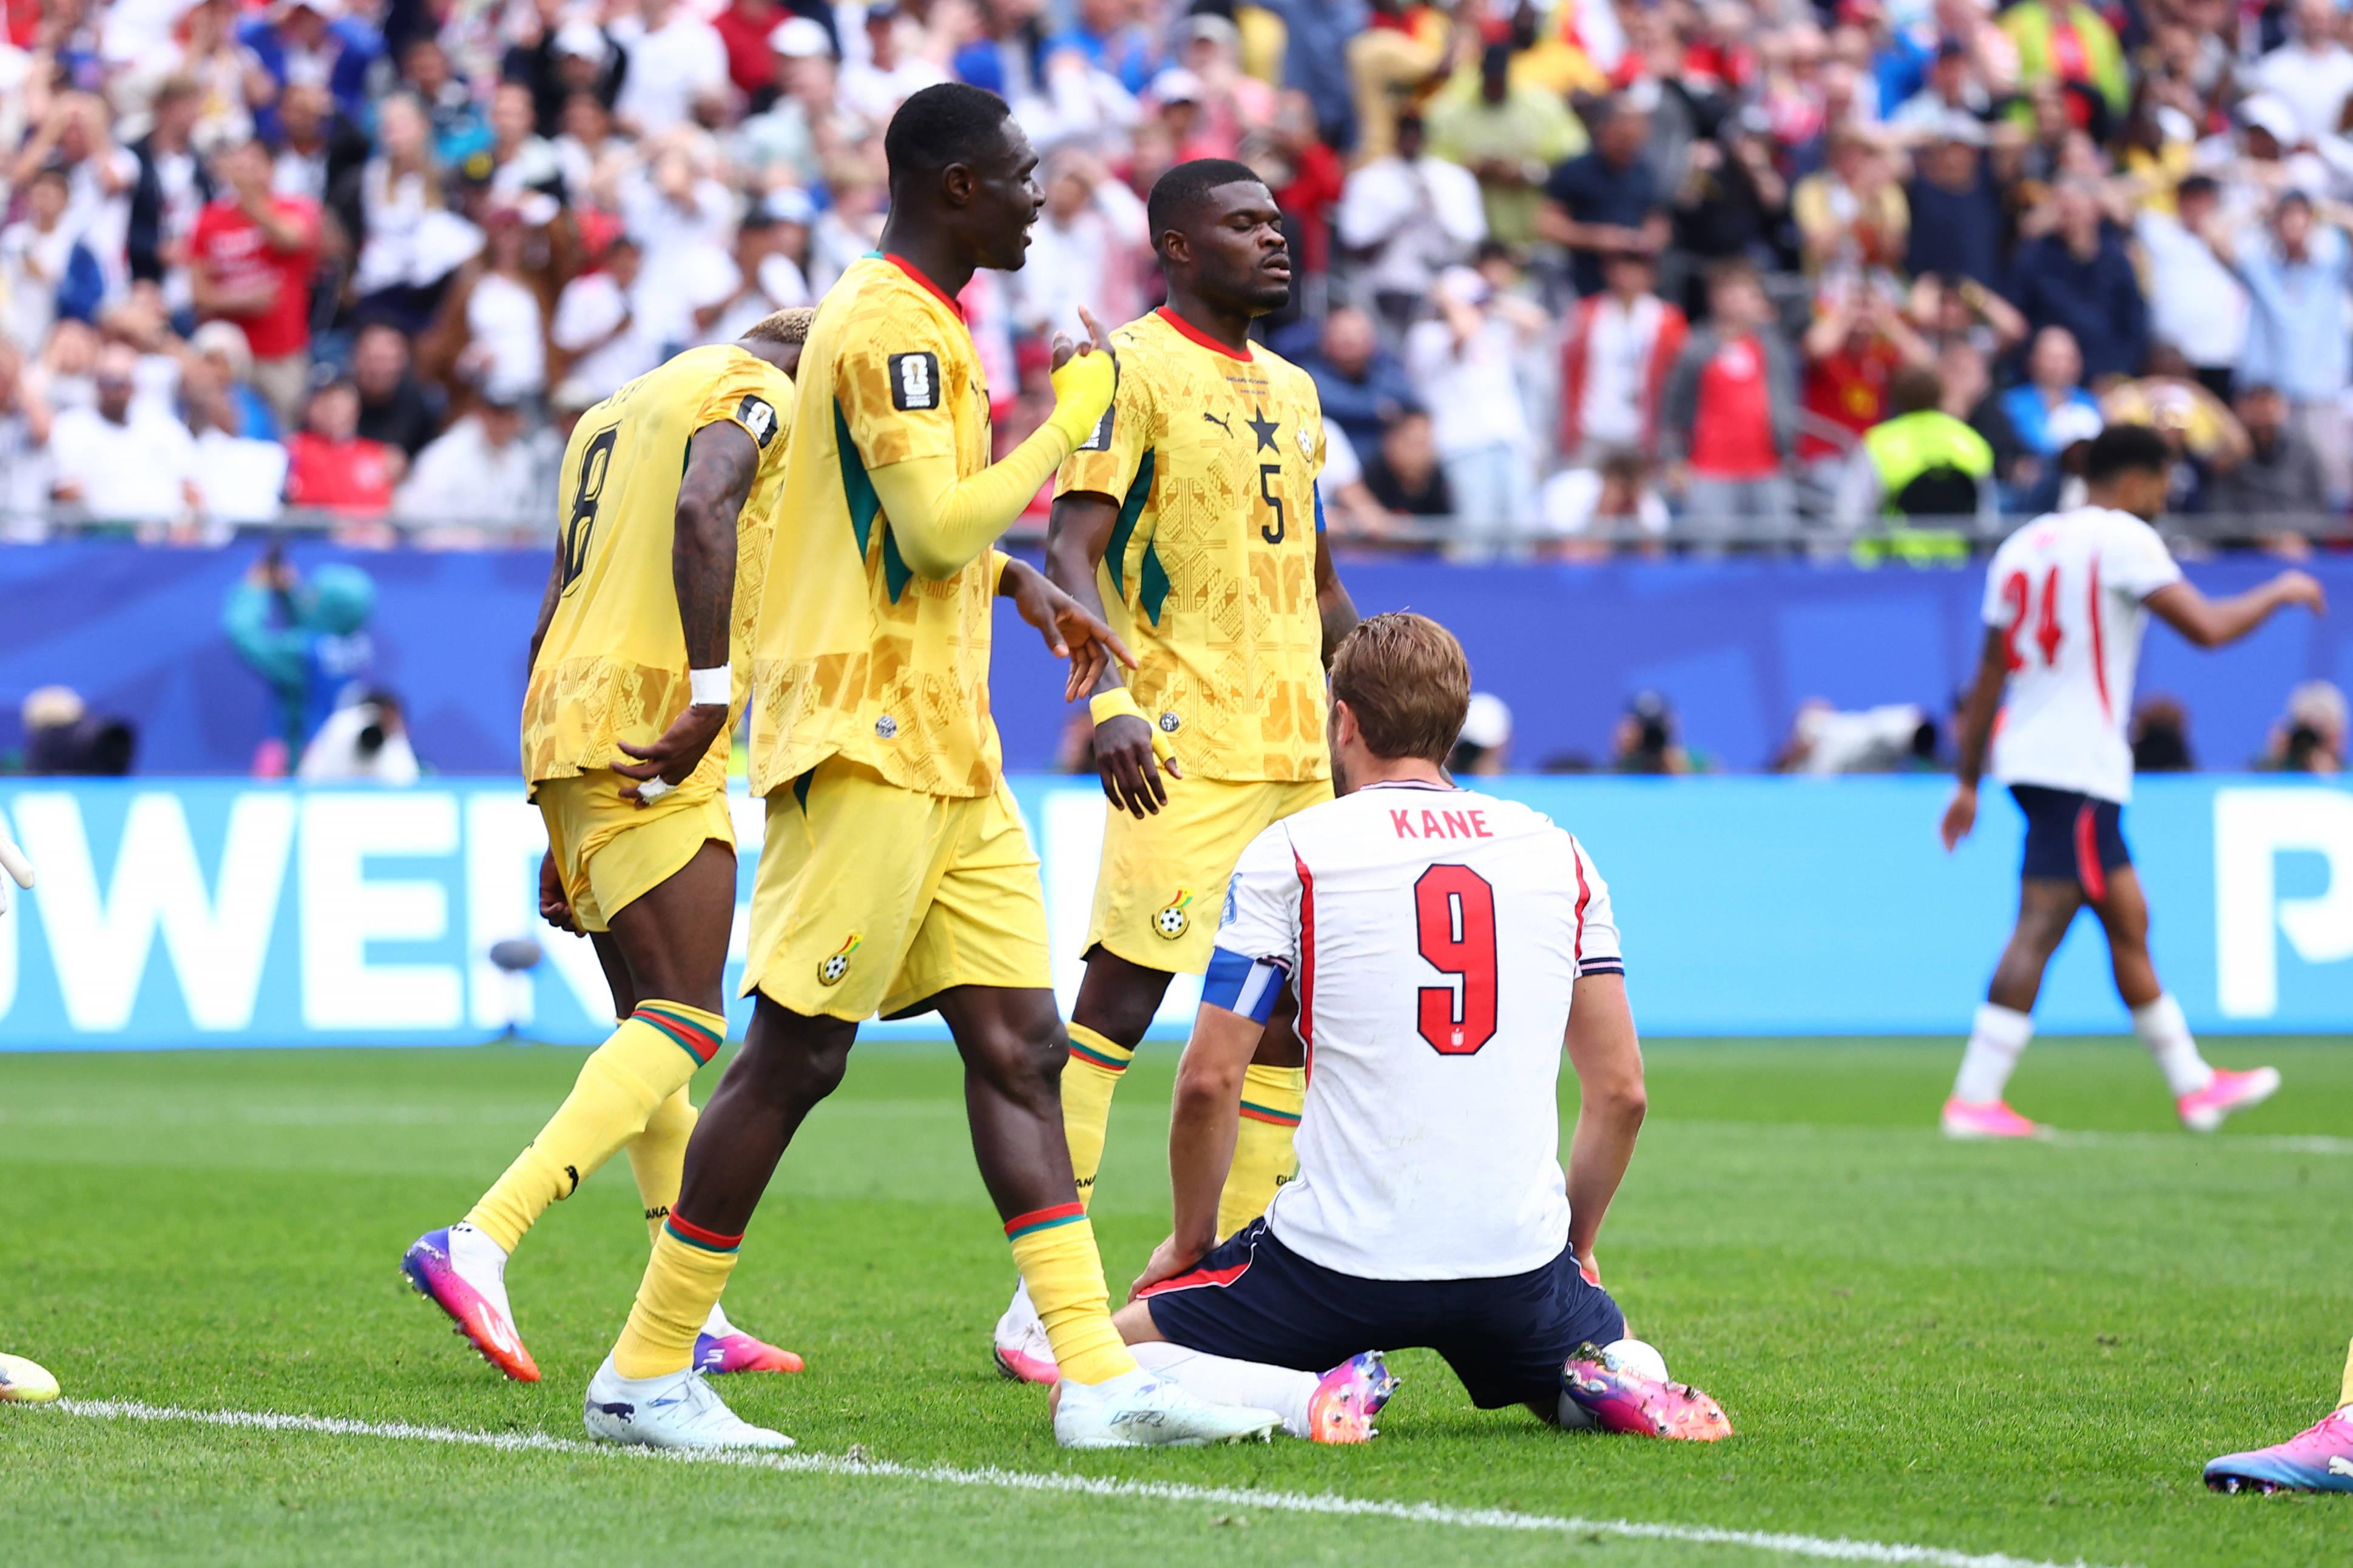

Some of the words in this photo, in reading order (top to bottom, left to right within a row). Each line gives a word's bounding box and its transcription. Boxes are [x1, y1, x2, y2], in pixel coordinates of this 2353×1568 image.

[562, 420, 623, 598] 8
[1260, 464, 1285, 545] 5
[2001, 564, 2063, 672] 24
[1389, 809, 1493, 839] KANE
[1414, 863, 1498, 1056] 9
